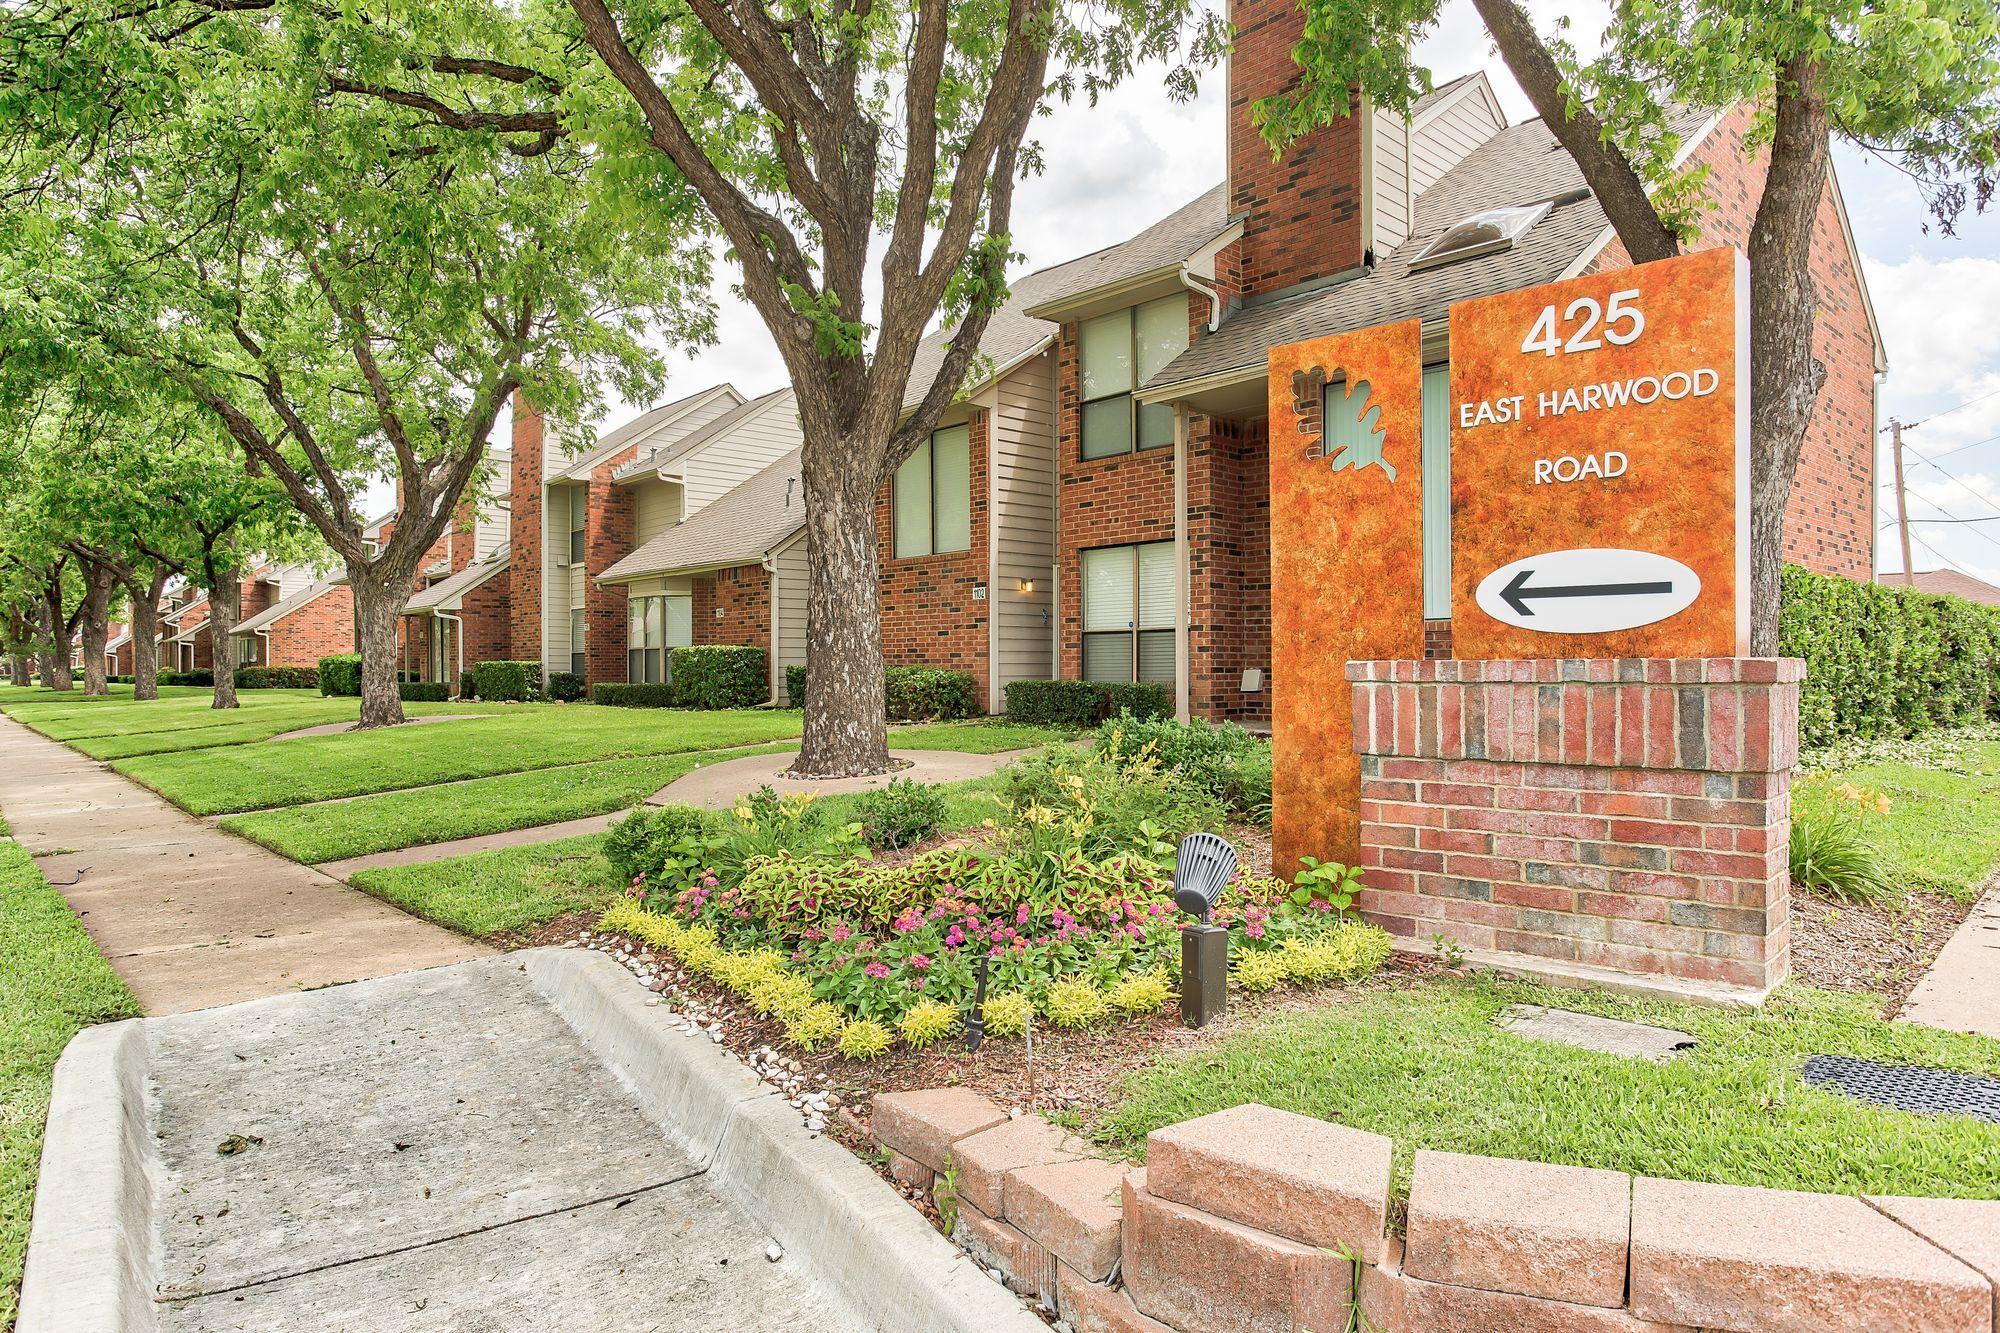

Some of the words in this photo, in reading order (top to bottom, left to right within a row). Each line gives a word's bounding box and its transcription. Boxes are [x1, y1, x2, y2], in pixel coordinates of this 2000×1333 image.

[1521, 289, 1646, 357] 425
[1460, 395, 1524, 428] EAST
[1538, 368, 1719, 416] HARWOOD
[1534, 451, 1628, 485] ROAD
